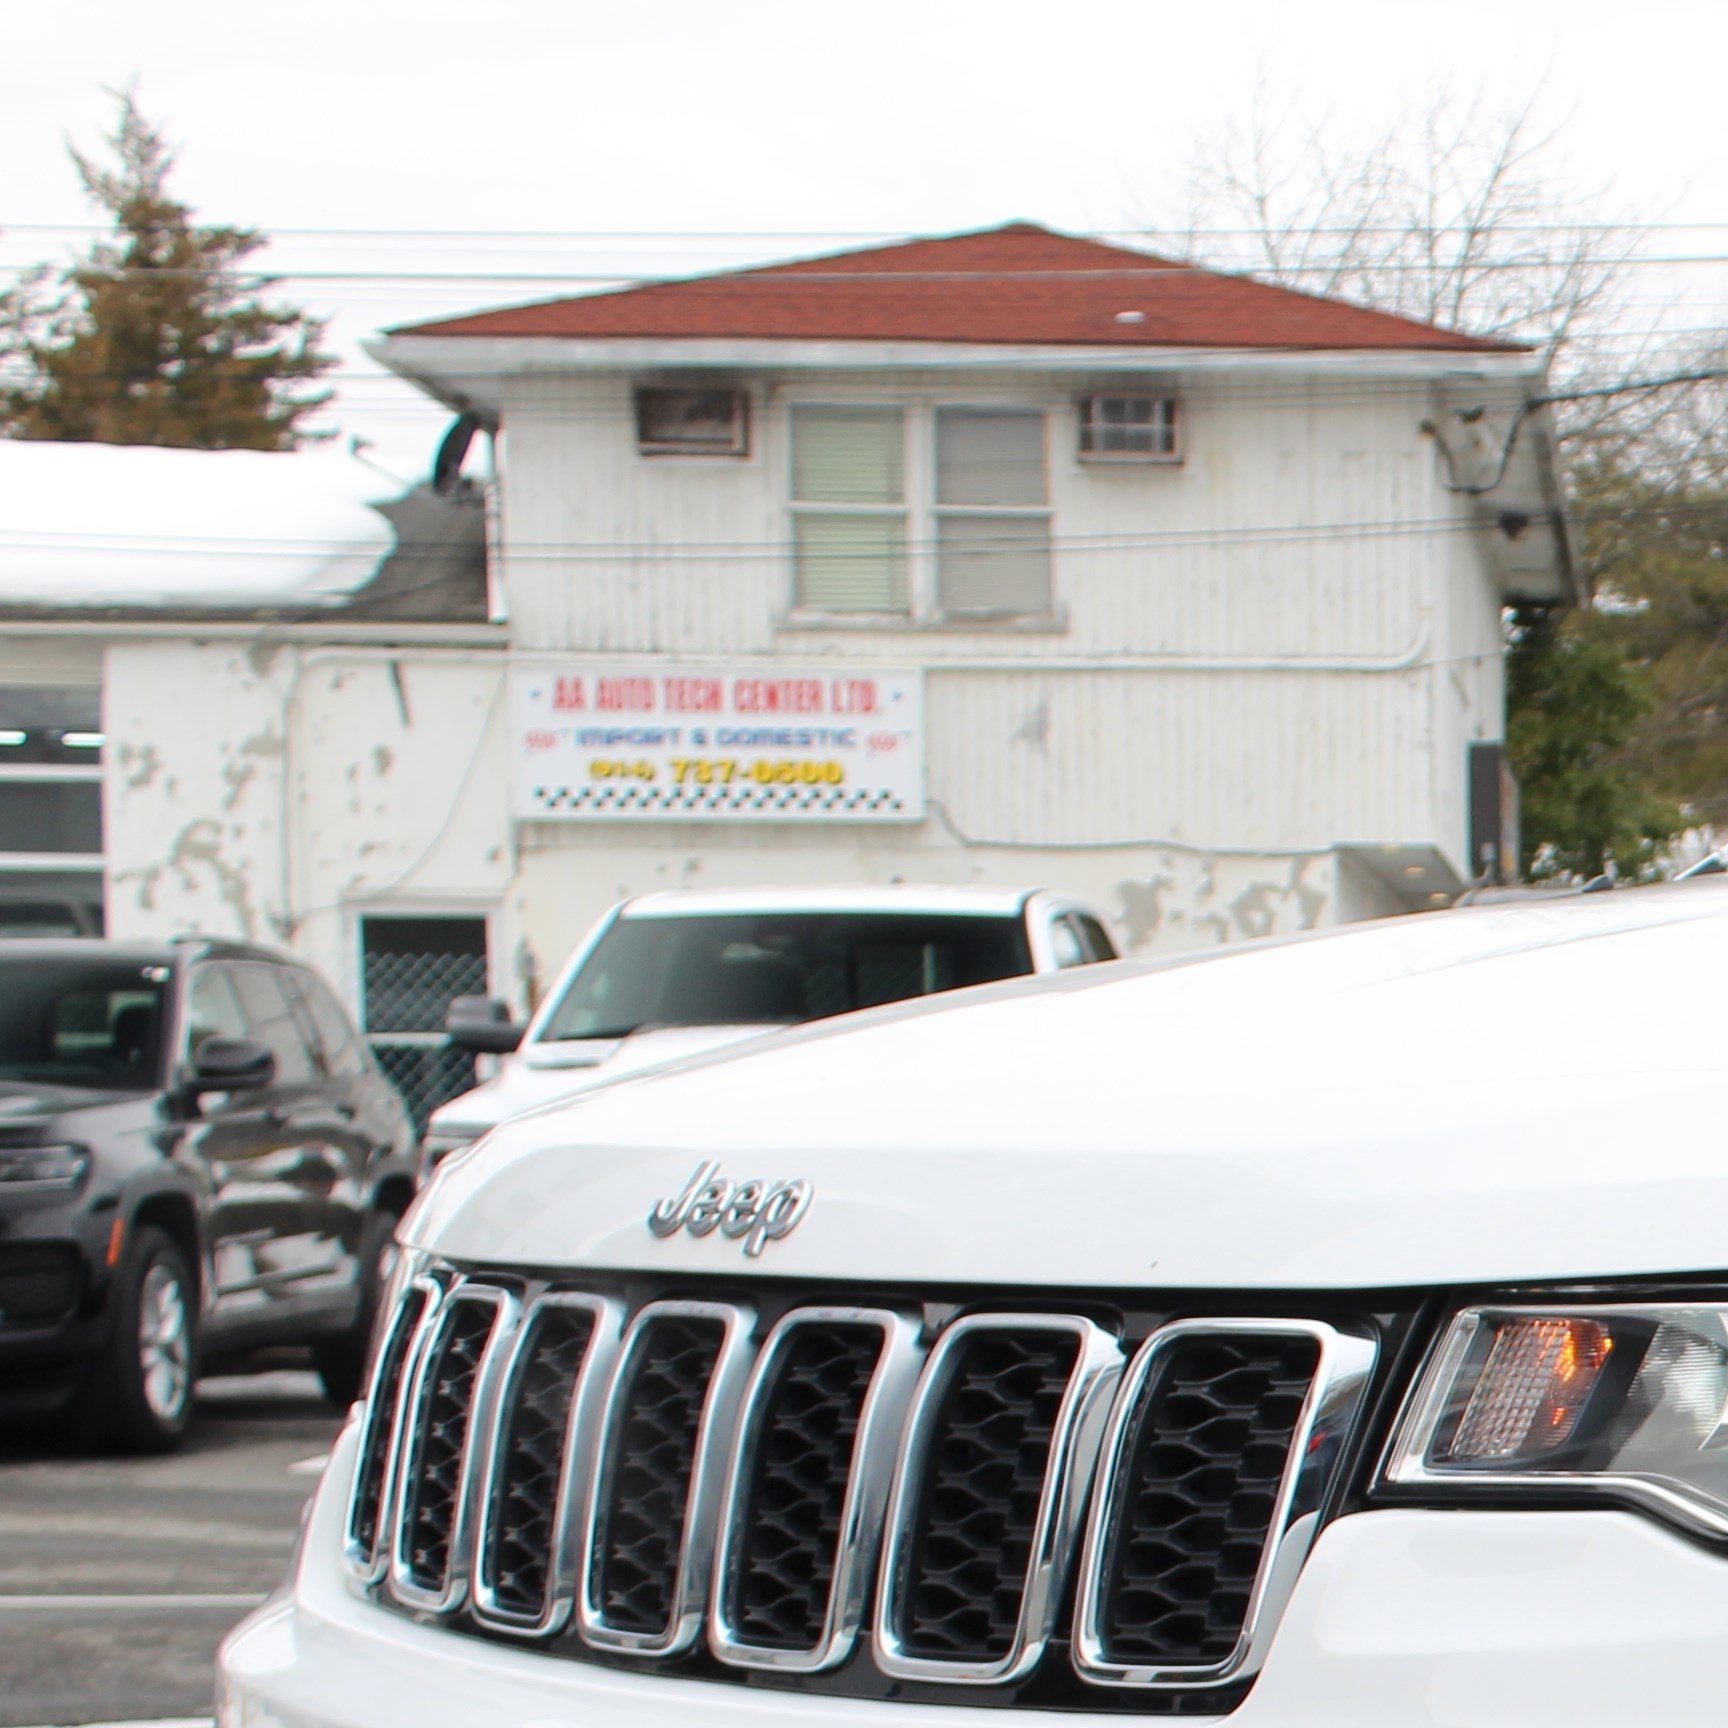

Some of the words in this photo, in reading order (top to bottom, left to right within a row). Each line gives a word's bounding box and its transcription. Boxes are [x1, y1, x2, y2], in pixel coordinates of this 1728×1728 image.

[553, 676, 585, 711] AA
[595, 677, 656, 712] AUTO
[664, 677, 723, 712] TECH
[734, 678, 823, 713] CENTER
[576, 727, 680, 747] IMPORT
[716, 728, 856, 748] DOMESTIC
[648, 1159, 814, 1257] Jeep
